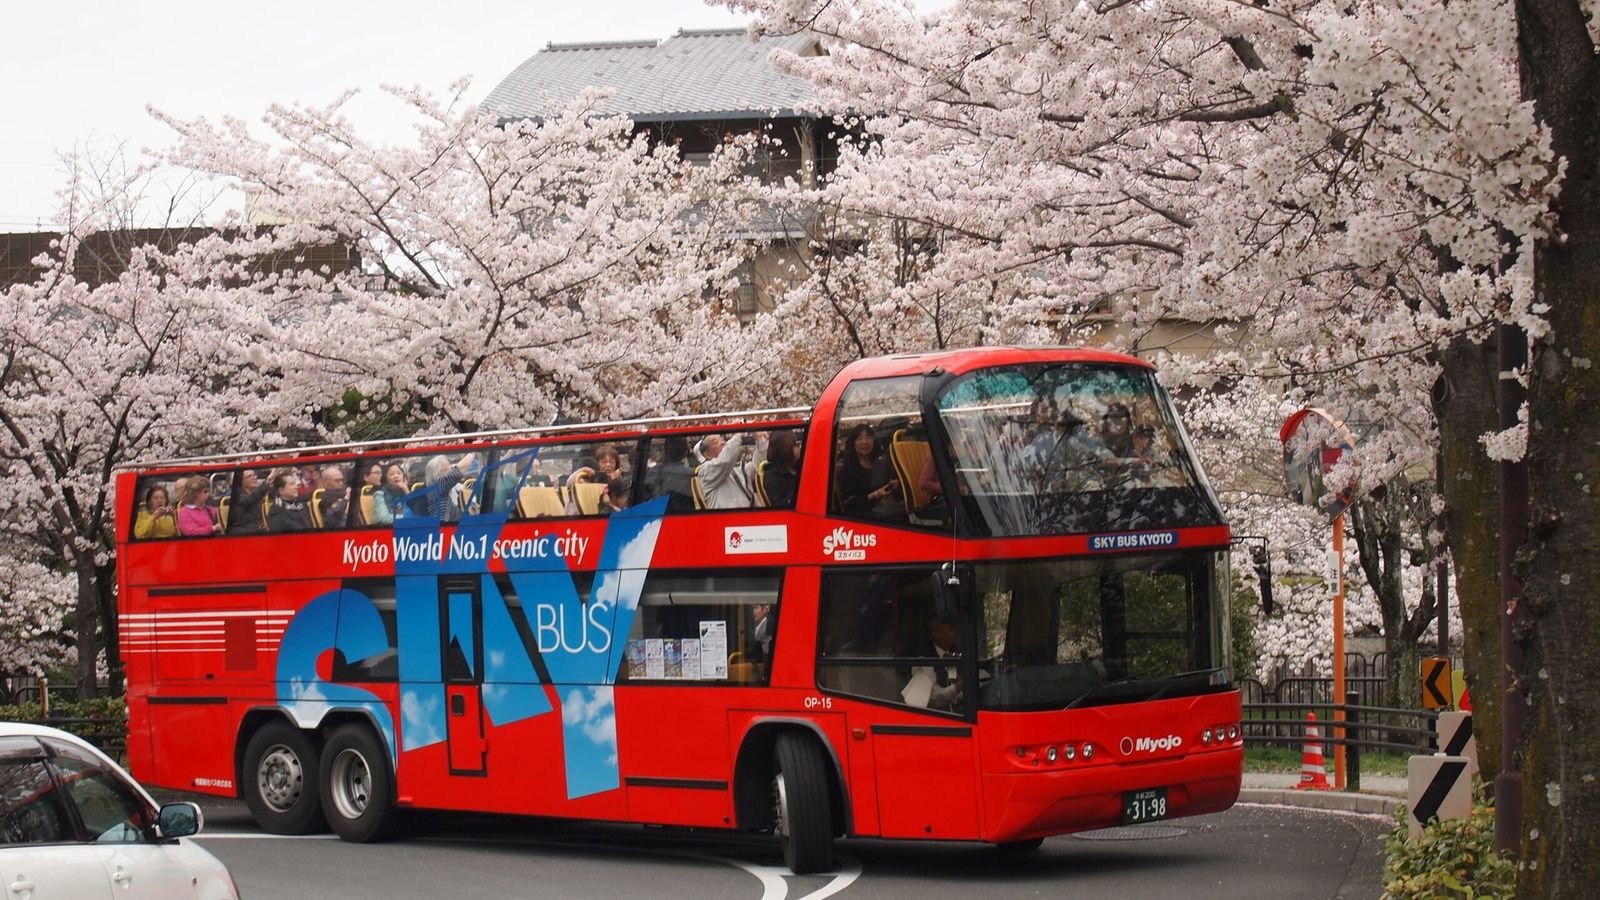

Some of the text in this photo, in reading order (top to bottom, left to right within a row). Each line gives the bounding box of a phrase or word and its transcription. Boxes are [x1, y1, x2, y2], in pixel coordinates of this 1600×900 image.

[343, 528, 589, 572] Kyoto World No.1 scenic city
[823, 526, 877, 555] SKY BUS
[1094, 532, 1173, 549] SKY BUS KYOTO
[537, 602, 611, 654] BUS
[804, 696, 832, 709] OP-15
[1135, 734, 1182, 752] Myojo
